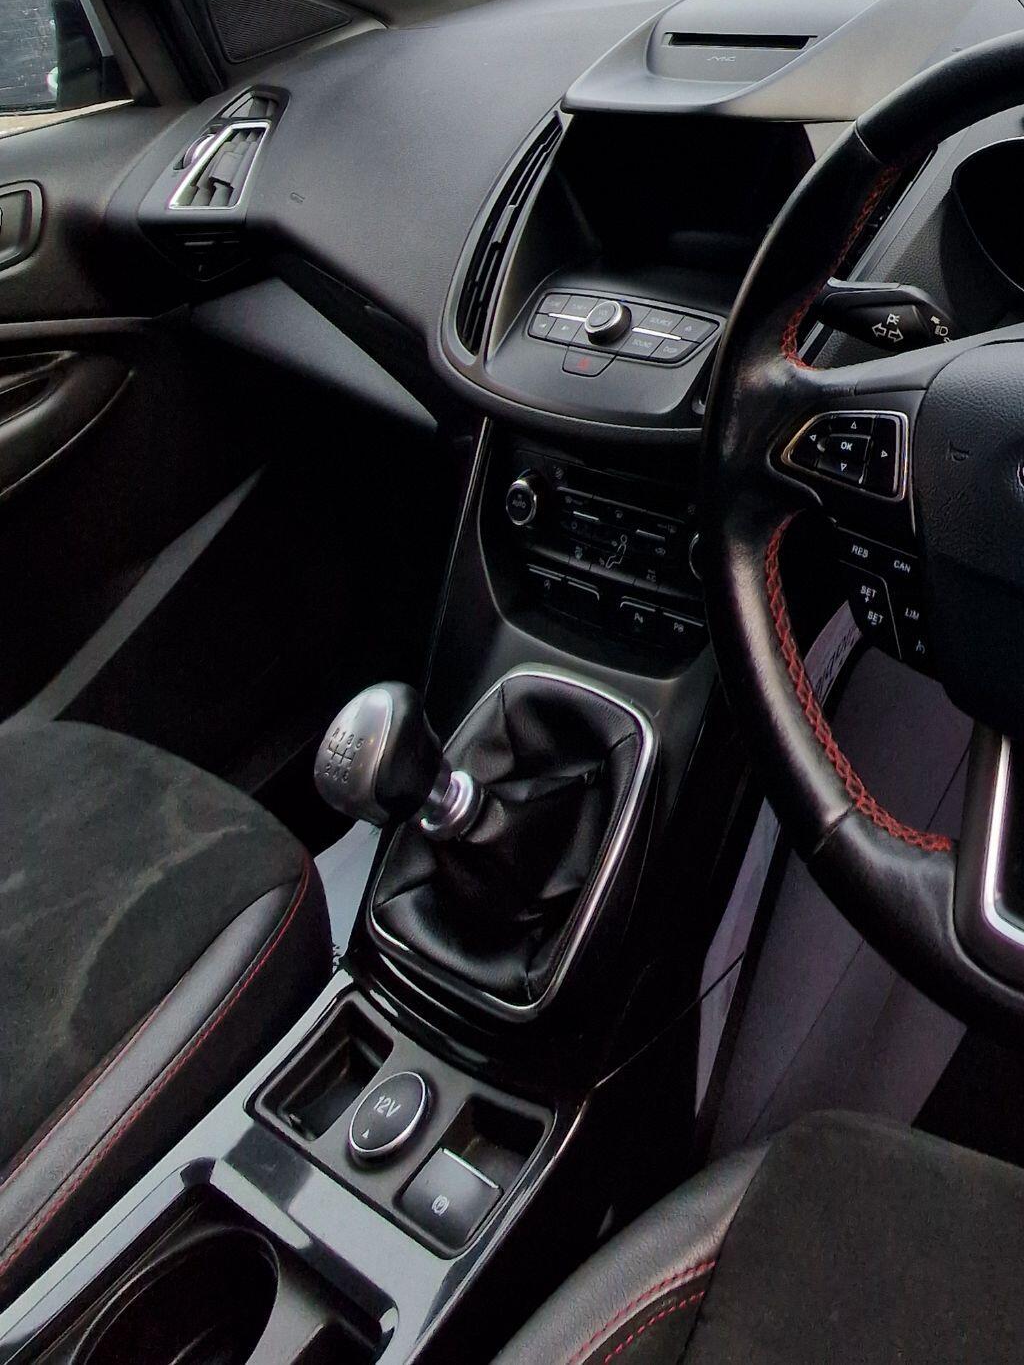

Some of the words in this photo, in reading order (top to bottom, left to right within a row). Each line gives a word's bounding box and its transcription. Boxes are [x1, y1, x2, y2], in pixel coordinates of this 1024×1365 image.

[840, 441, 853, 452] OK
[893, 560, 911, 573] CAN
[860, 585, 877, 598] SET
[867, 610, 884, 624] SET
[373, 1094, 402, 1119] 12V
